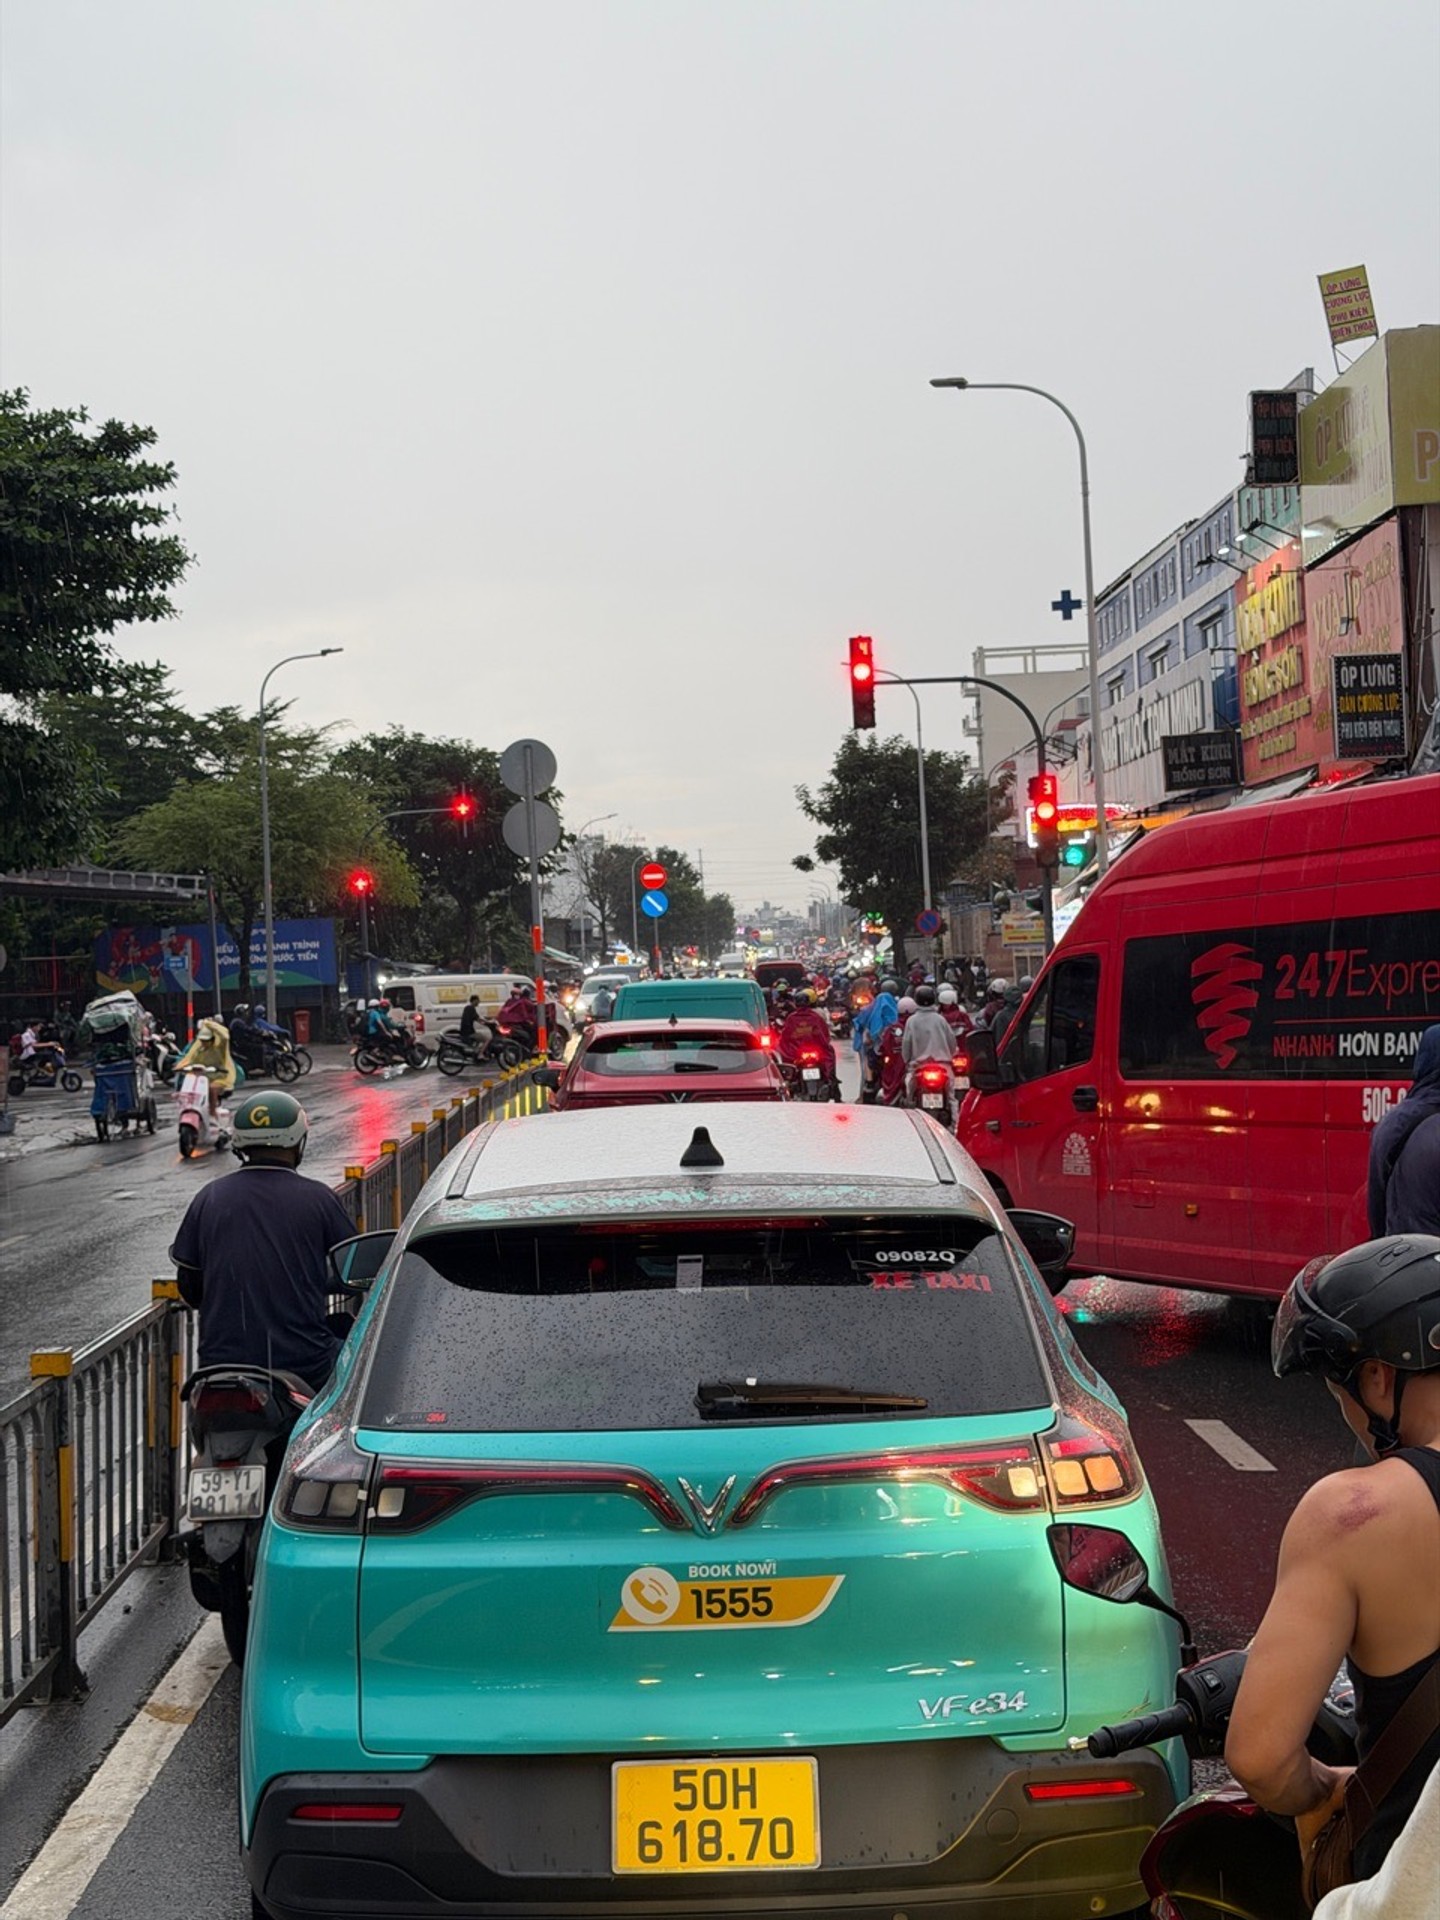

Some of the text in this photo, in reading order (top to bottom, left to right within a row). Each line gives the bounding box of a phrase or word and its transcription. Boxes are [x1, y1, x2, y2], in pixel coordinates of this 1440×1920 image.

[1360, 662, 1396, 687] LƯNG
[1273, 1033, 1337, 1057] NHANH
[1338, 1031, 1380, 1057] HƠN
[875, 1250, 956, 1264] 09082Q
[868, 1271, 993, 1293] XE TAXI
[688, 1562, 777, 1579] BOOK NOW!
[690, 1586, 774, 1619] 1555
[673, 1767, 757, 1812] 50H
[637, 1817, 795, 1864] 618.70
